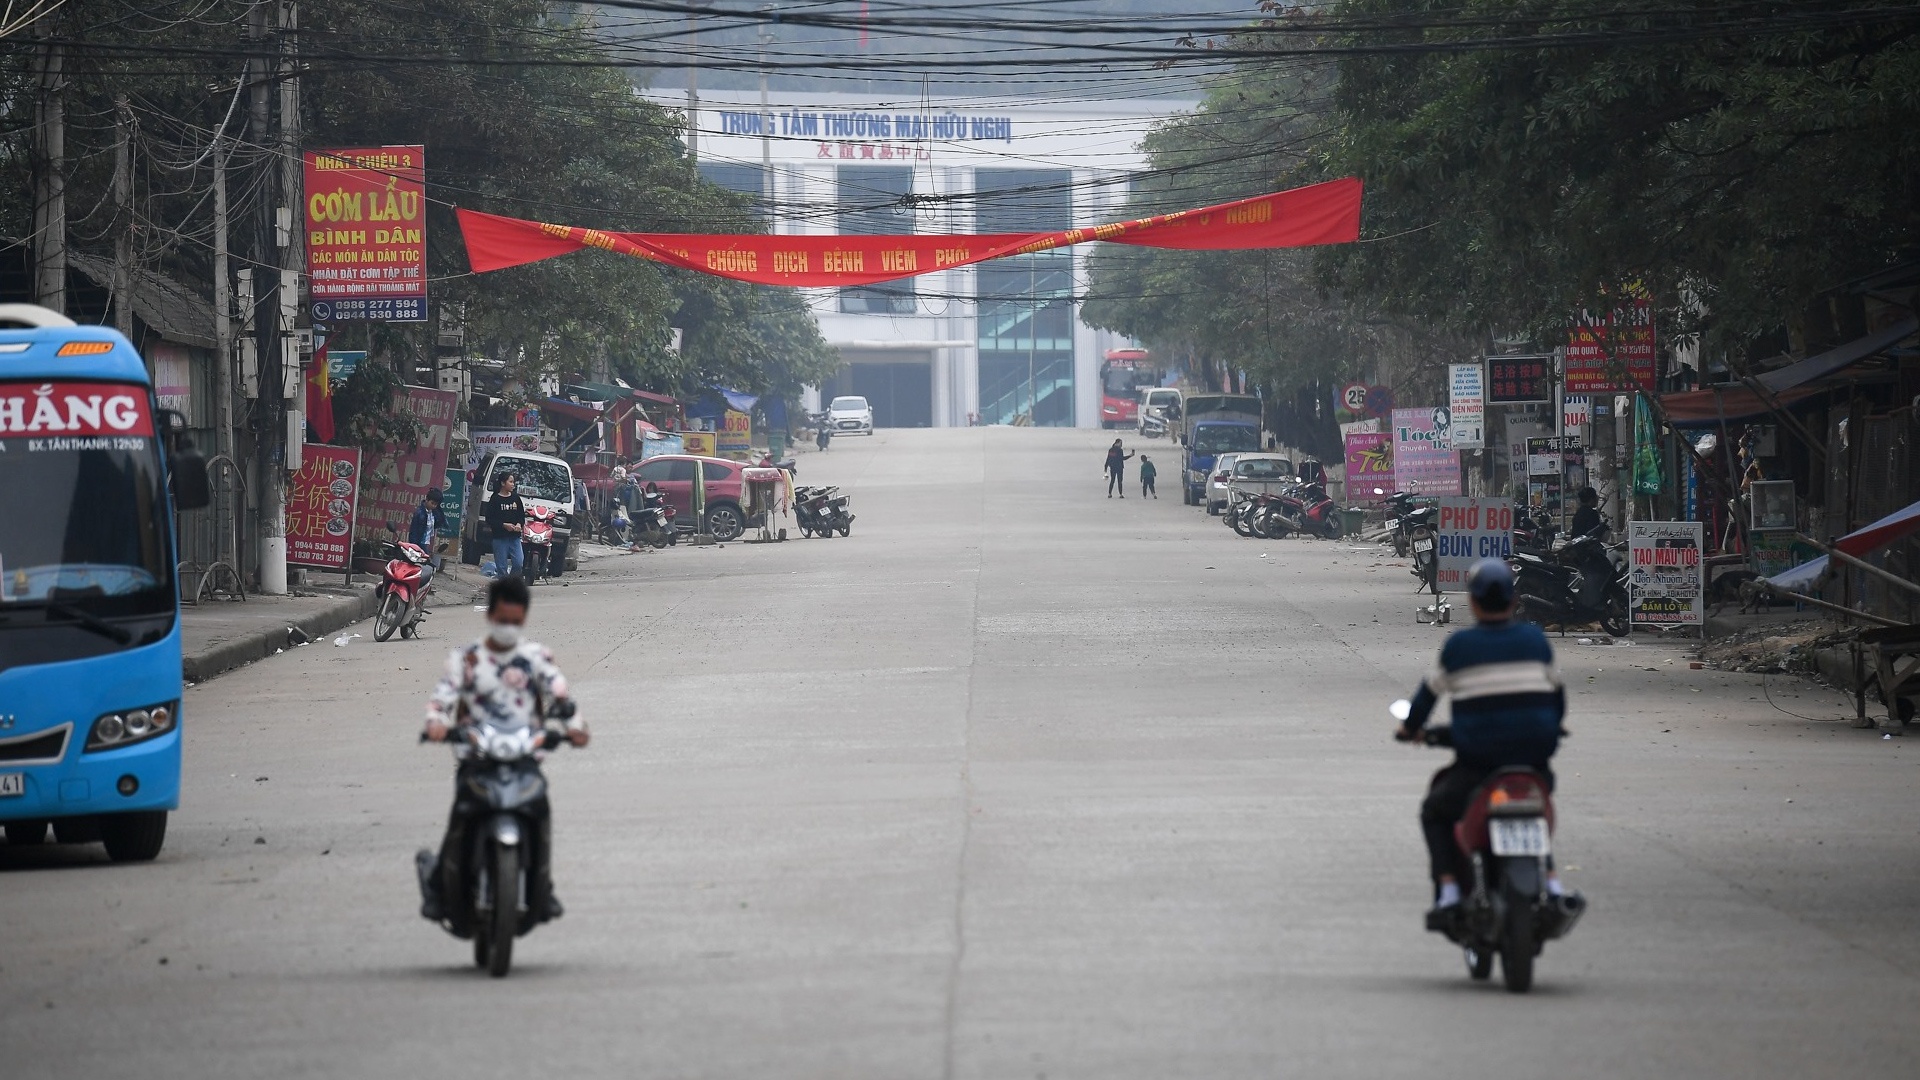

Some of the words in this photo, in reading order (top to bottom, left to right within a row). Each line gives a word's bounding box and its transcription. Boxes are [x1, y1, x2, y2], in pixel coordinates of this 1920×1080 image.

[720, 111, 775, 134] TRUNG
[782, 108, 818, 136] TÂM
[824, 112, 891, 137] THƯƠNG
[971, 117, 1011, 143] NGHỊ
[403, 155, 411, 168] 3
[310, 187, 362, 222] CƠM
[368, 175, 418, 220] LẨU
[310, 228, 366, 246] BÌNH
[376, 226, 421, 244] DÂN
[312, 249, 332, 263] CÁC
[335, 249, 358, 263] MÓN
[361, 249, 374, 263] ĂN
[378, 248, 397, 262] DÂN
[400, 248, 419, 264] TỘC
[707, 243, 758, 272] CHỐNG
[774, 251, 808, 278] DỊCH
[824, 247, 864, 278] BỆNH
[881, 247, 917, 271] VIÊM
[312, 268, 338, 281] NHẬN
[340, 267, 358, 281] ĐẶT
[360, 268, 381, 279] CƠM
[383, 266, 400, 280] TẬP
[403, 264, 420, 278] THỂ
[327, 283, 346, 293] HÀNG
[347, 283, 365, 294] RỘNG
[379, 282, 404, 292] THOÁNG
[336, 301, 366, 310] 0986
[370, 300, 392, 309] 277
[396, 300, 418, 308] 594
[336, 311, 366, 320] 0944
[370, 310, 392, 319] 530
[396, 310, 418, 318] 888
[1581, 346, 1598, 355] QUAY
[1348, 390, 1364, 404] 25
[443, 401, 450, 420] 3
[1452, 405, 1465, 414] ĐIỆN
[1467, 404, 1482, 413] NƯỚC
[1441, 498, 1480, 531] PHỞ
[1487, 503, 1512, 531] BÒ
[315, 542, 328, 551] 530
[1439, 531, 1473, 557] BÚN
[1480, 531, 1511, 557] CHẢ
[1634, 548, 1652, 567] TẠO
[1438, 567, 1460, 583] BÚN
[1642, 600, 1662, 611] BẤM
[1678, 603, 1692, 611] TAI
[2, 775, 19, 791] 41
